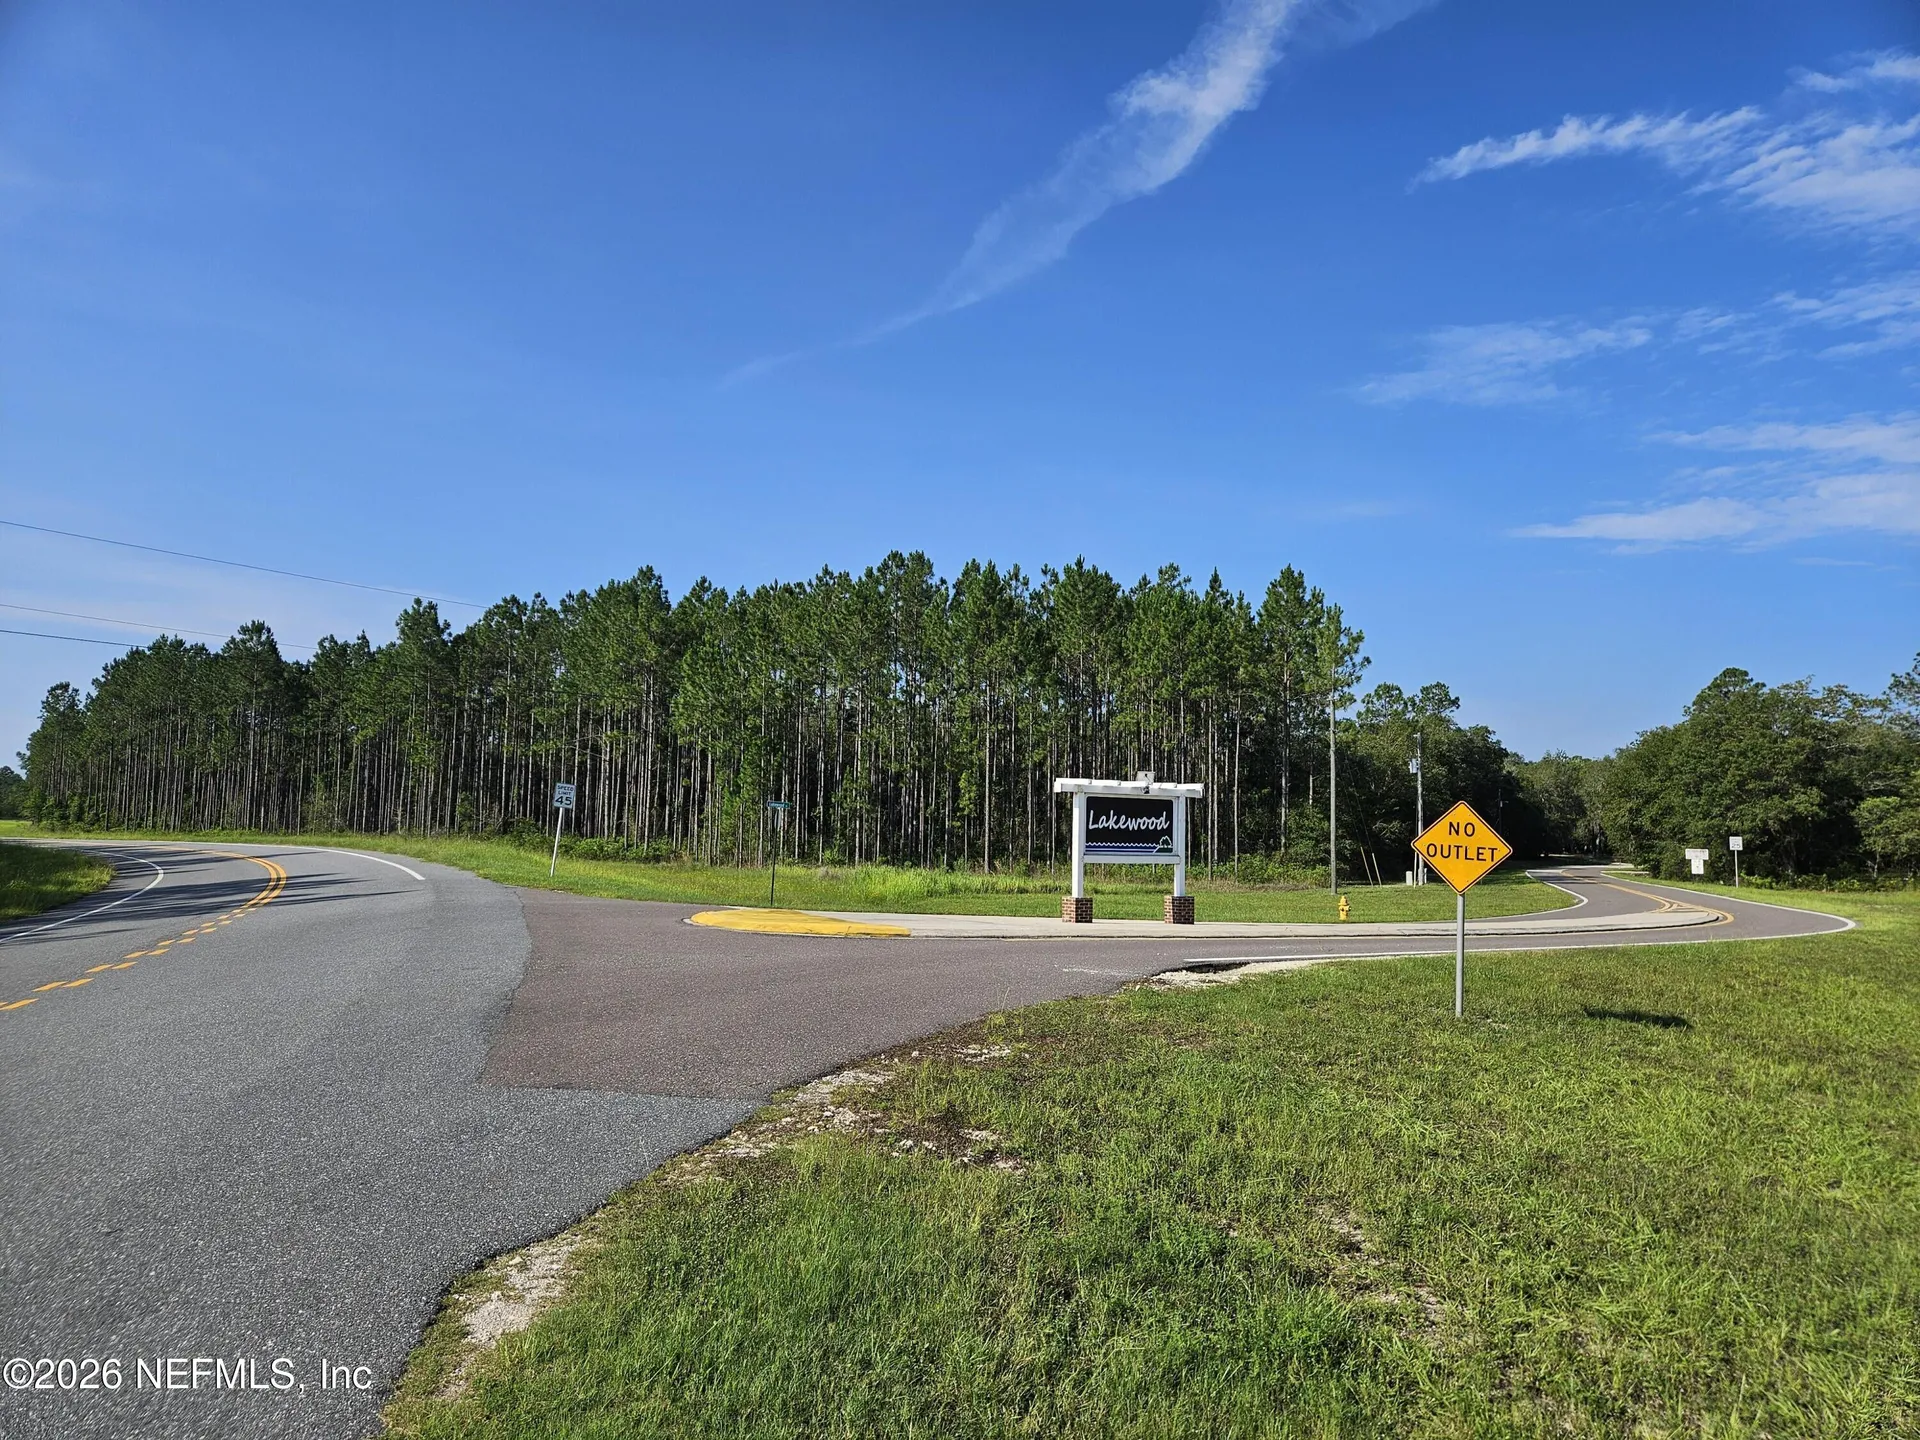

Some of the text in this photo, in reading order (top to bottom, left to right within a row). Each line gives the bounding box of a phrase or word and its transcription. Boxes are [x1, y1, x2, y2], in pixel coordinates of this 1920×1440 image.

[555, 796, 572, 805] 45
[1089, 810, 1170, 831] Lakewood
[1448, 821, 1475, 837] NO
[1426, 843, 1498, 862] OUTLET
